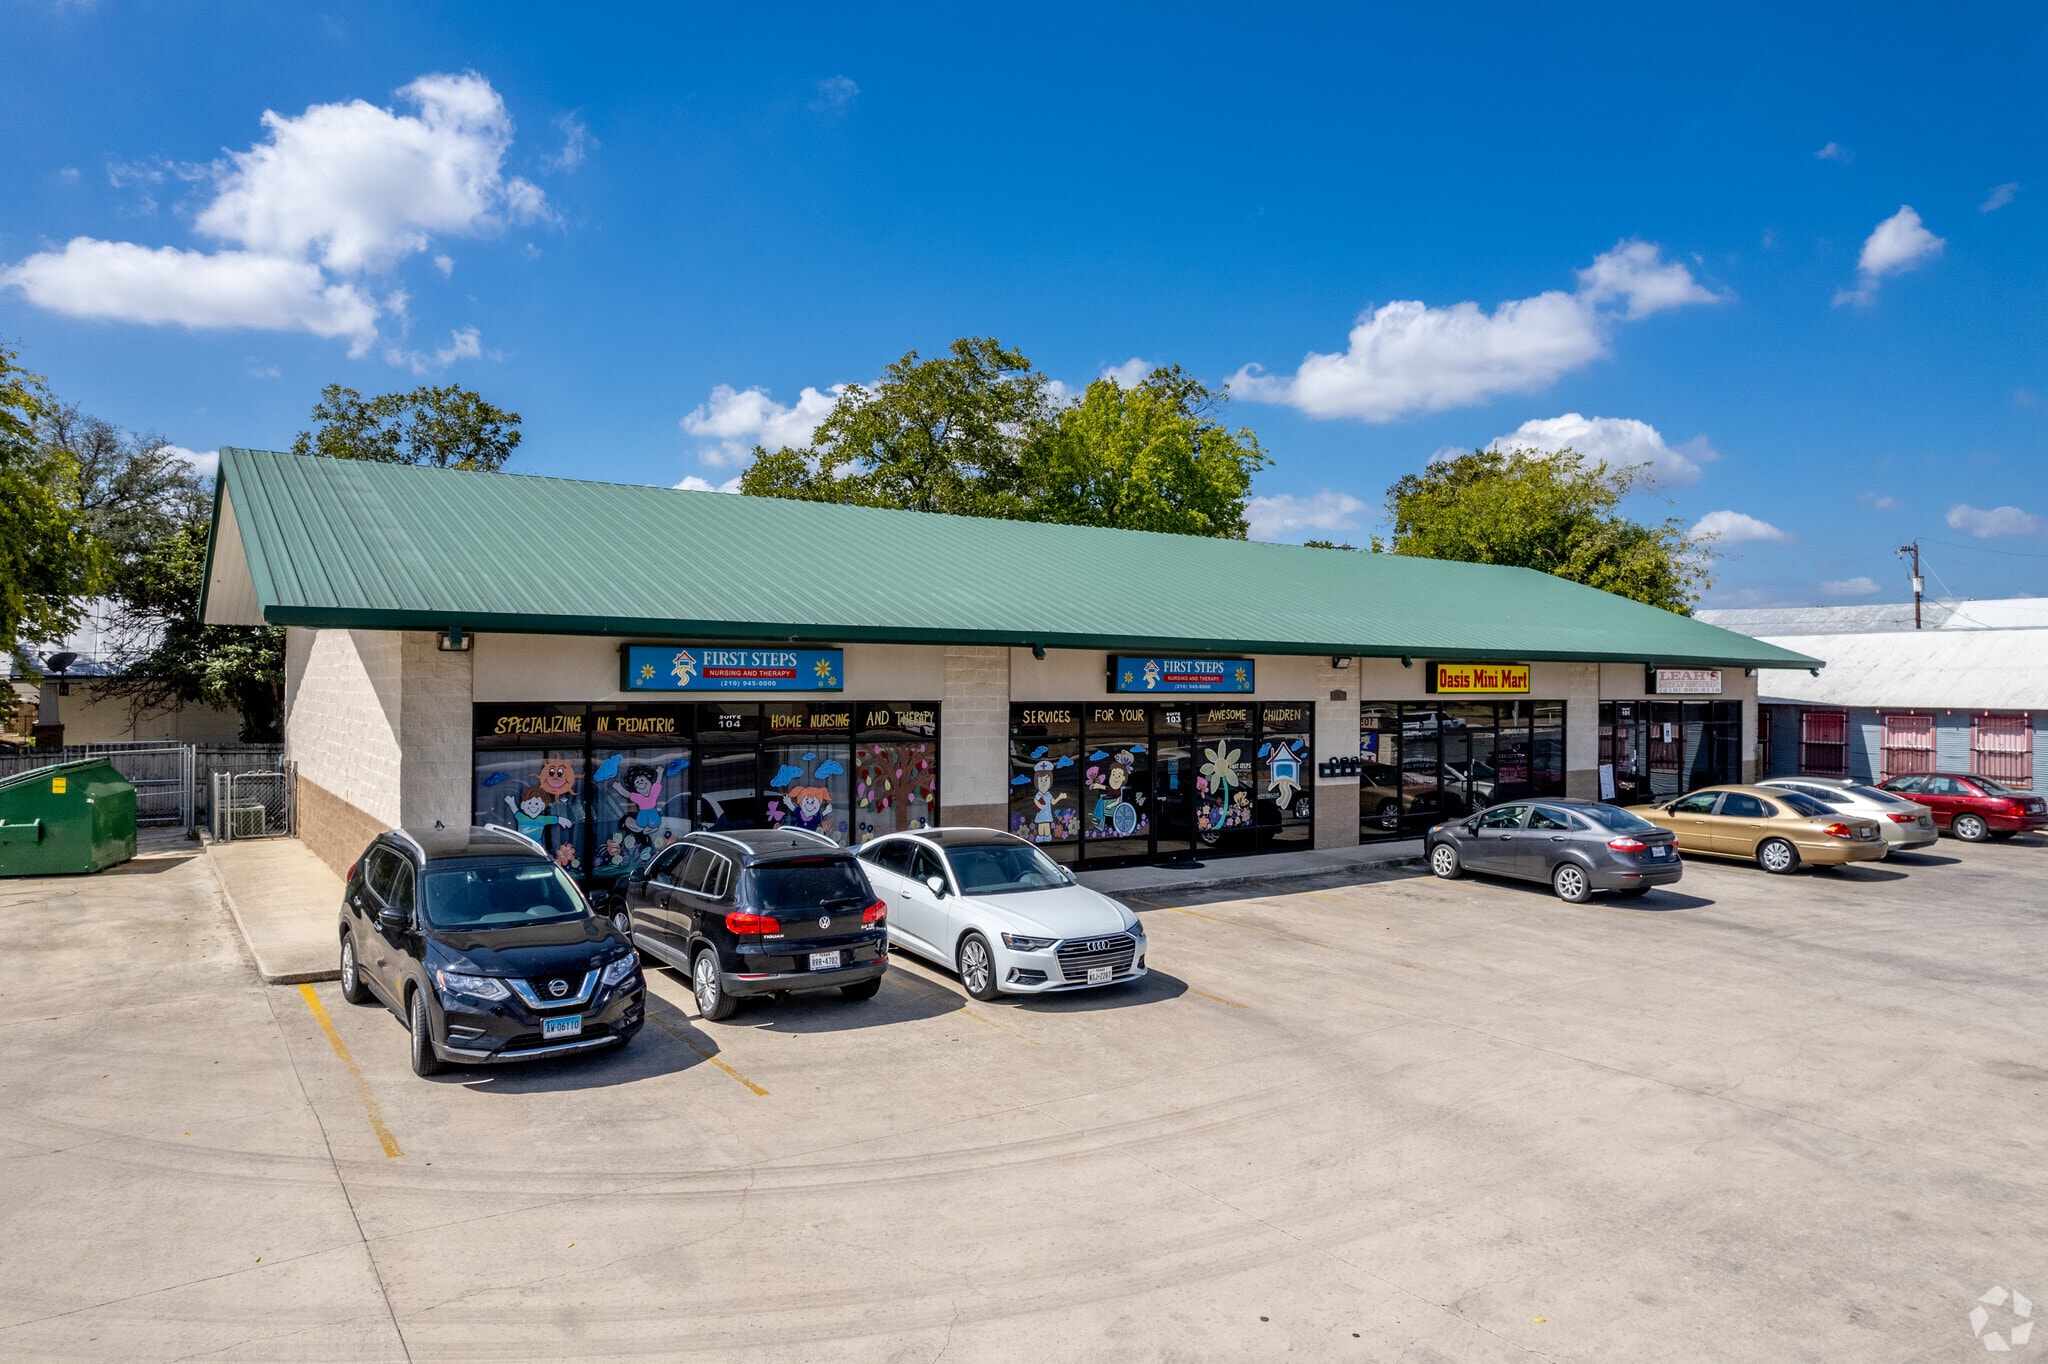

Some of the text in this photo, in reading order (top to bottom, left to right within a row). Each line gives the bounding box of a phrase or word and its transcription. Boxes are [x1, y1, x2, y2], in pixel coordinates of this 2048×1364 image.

[702, 651, 798, 667] FIRST STEPS
[709, 669, 742, 677] NURSING
[759, 670, 791, 678] THERAPY
[1163, 661, 1224, 673] FIRST STEPS
[1439, 668, 1527, 688] Oasis Mini Mart
[1659, 671, 1720, 680] LEAH'S
[720, 680, 777, 688] (210) 945-0000
[771, 710, 935, 729] HOME NURSING AND THERAPY
[1022, 709, 1145, 724] SERVICES FOR YOUR
[1207, 708, 1301, 722] AWESOME CHILDREN
[494, 715, 675, 735] SPECIALIZING IN PEDIATRIC
[718, 720, 741, 729] 104
